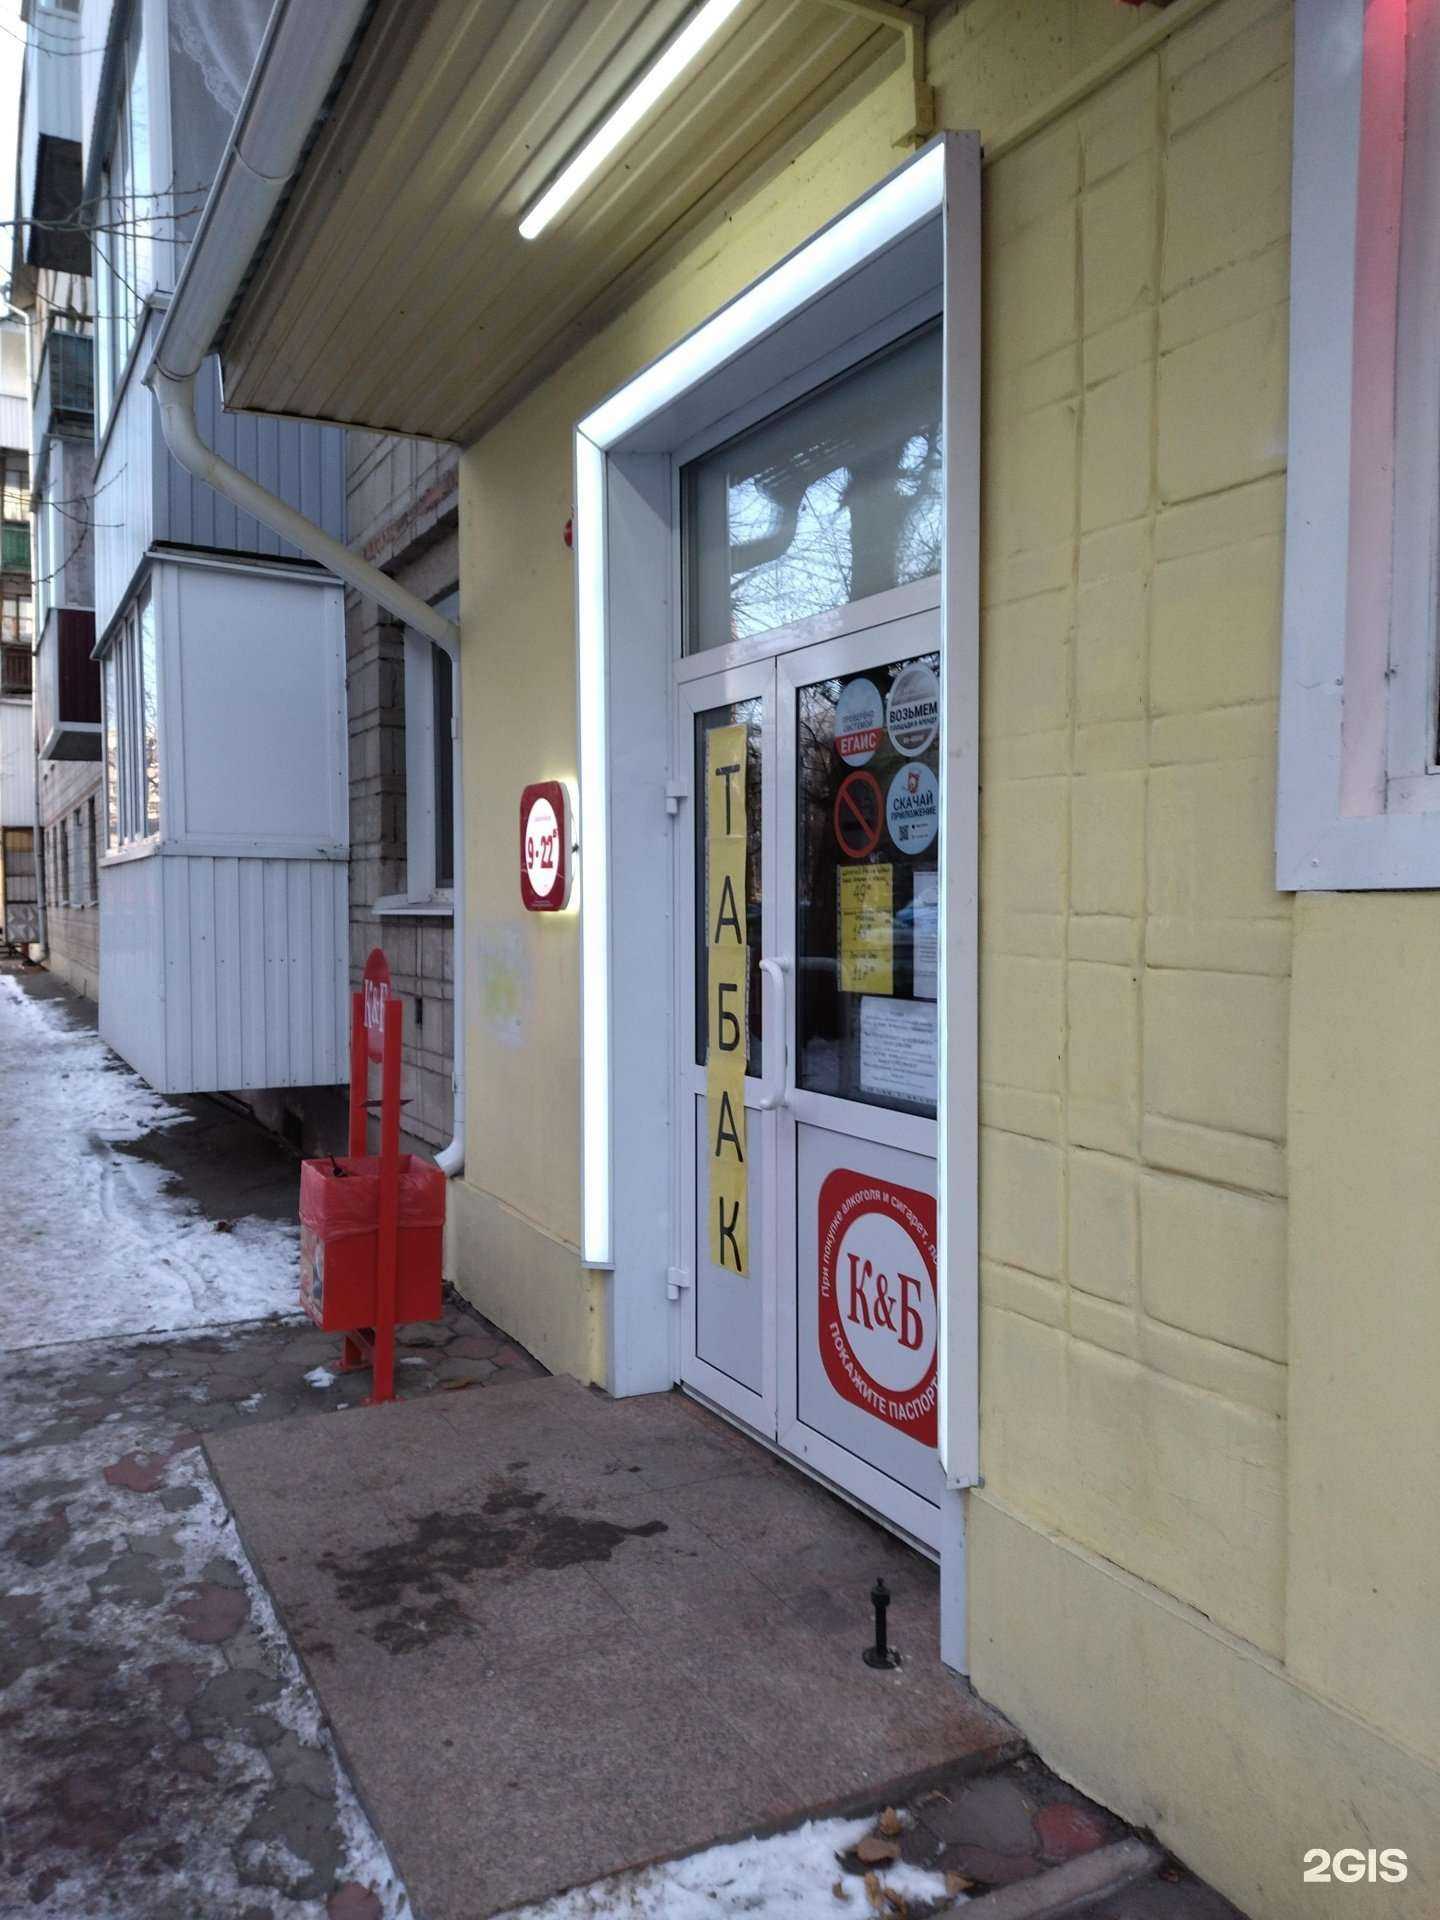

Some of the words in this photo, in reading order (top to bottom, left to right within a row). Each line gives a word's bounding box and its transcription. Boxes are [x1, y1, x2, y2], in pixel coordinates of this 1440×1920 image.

[889, 701, 938, 723] ВОЗЬМЕМ
[841, 732, 877, 754] ЕГАИС
[893, 790, 933, 811] СКАЧАЙ
[714, 763, 744, 1272] ТАБАК
[841, 1188, 881, 1215] алкоголя
[846, 1251, 924, 1351] К&Б
[829, 1321, 888, 1416] ПОКАЖИТЕ
